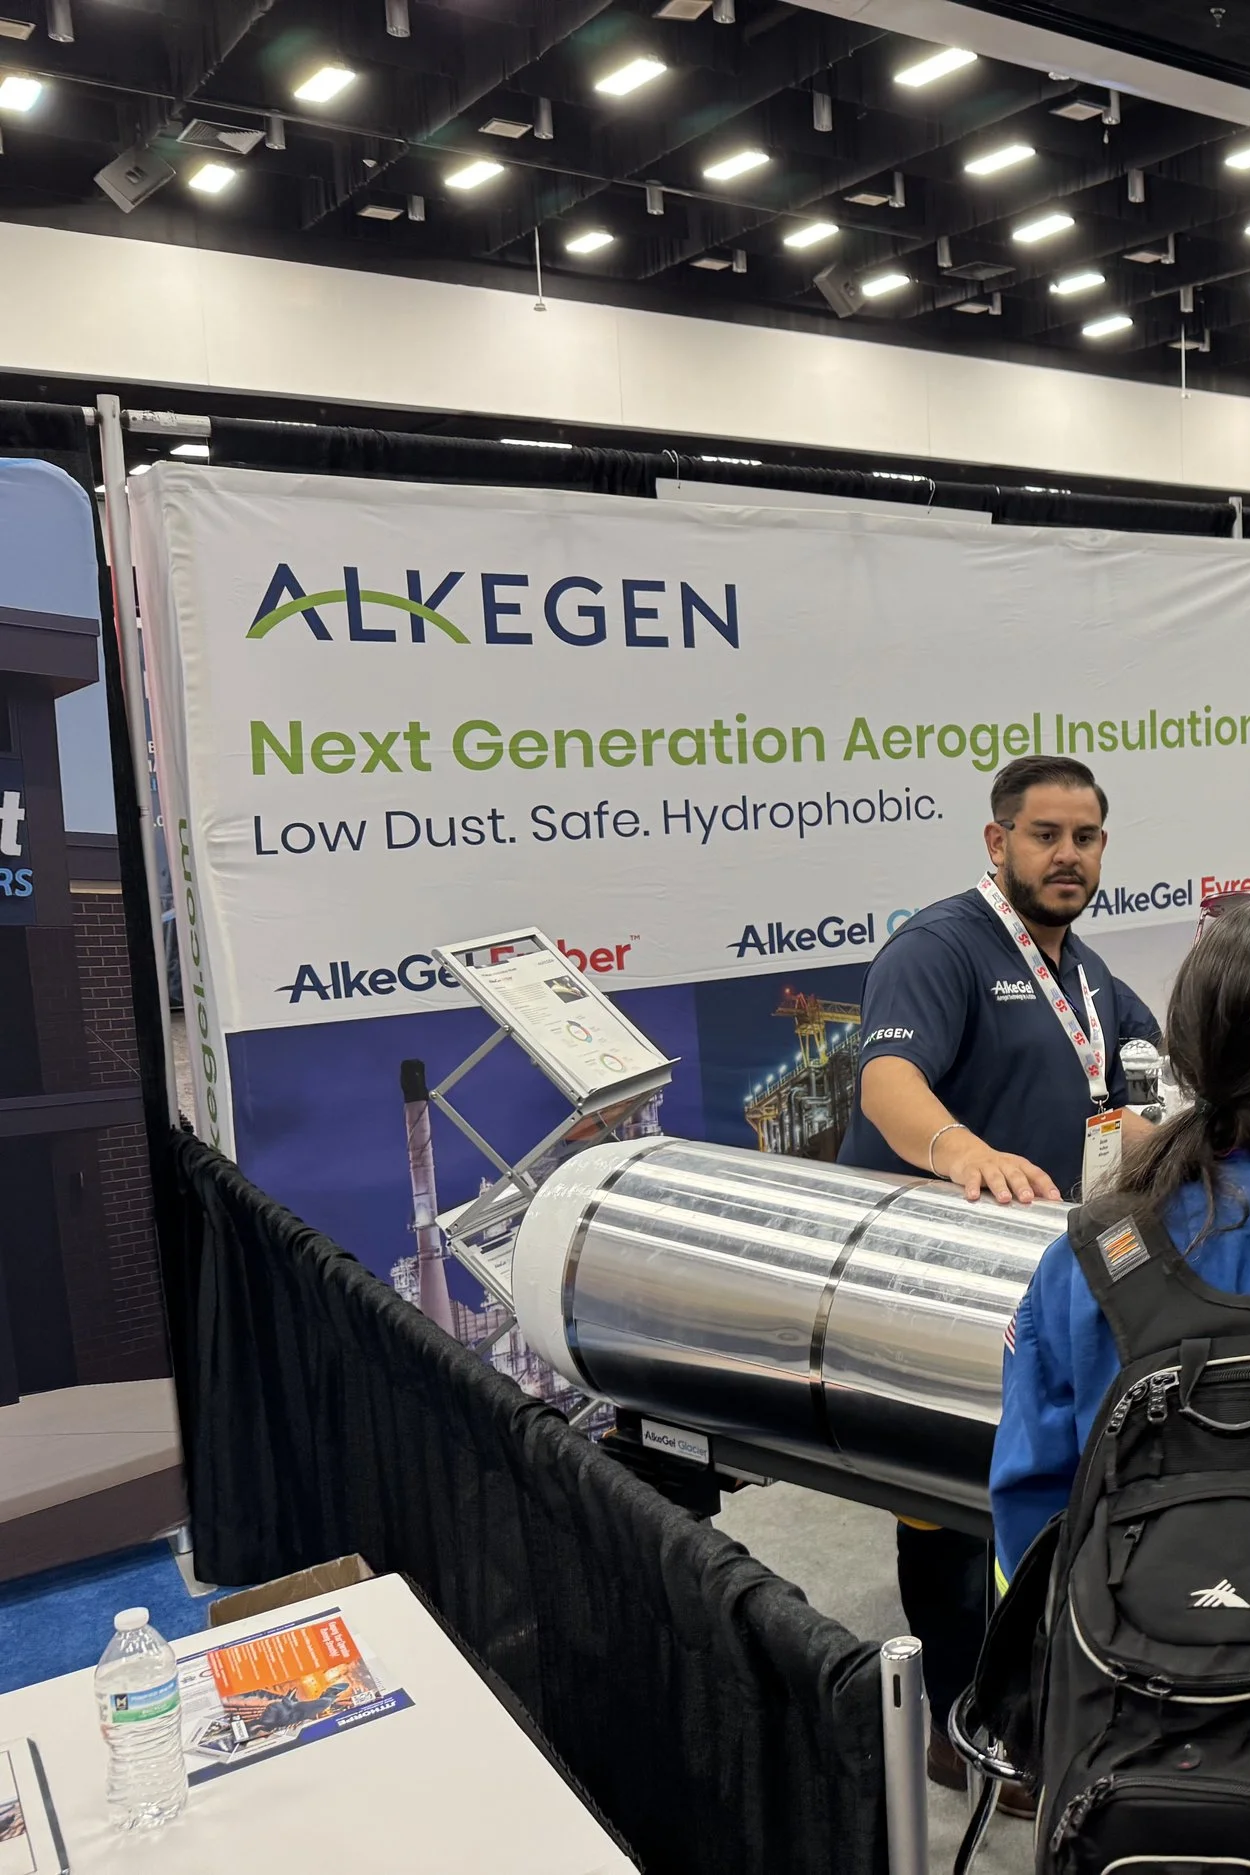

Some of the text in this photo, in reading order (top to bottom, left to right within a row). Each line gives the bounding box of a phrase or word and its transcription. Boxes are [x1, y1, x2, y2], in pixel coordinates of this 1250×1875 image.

[246, 563, 740, 648] ALKEGEN
[250, 720, 432, 775] Next
[452, 713, 825, 771] Generation
[843, 712, 1042, 772] Aerogel
[254, 787, 943, 855] Low Dust. Safe. Hydrophobic.
[1087, 879, 1193, 918] AlkeGel
[727, 912, 875, 958] AlkeGel
[991, 980, 1035, 995] AlkeGel
[644, 1430, 676, 1448] AlkeGel
